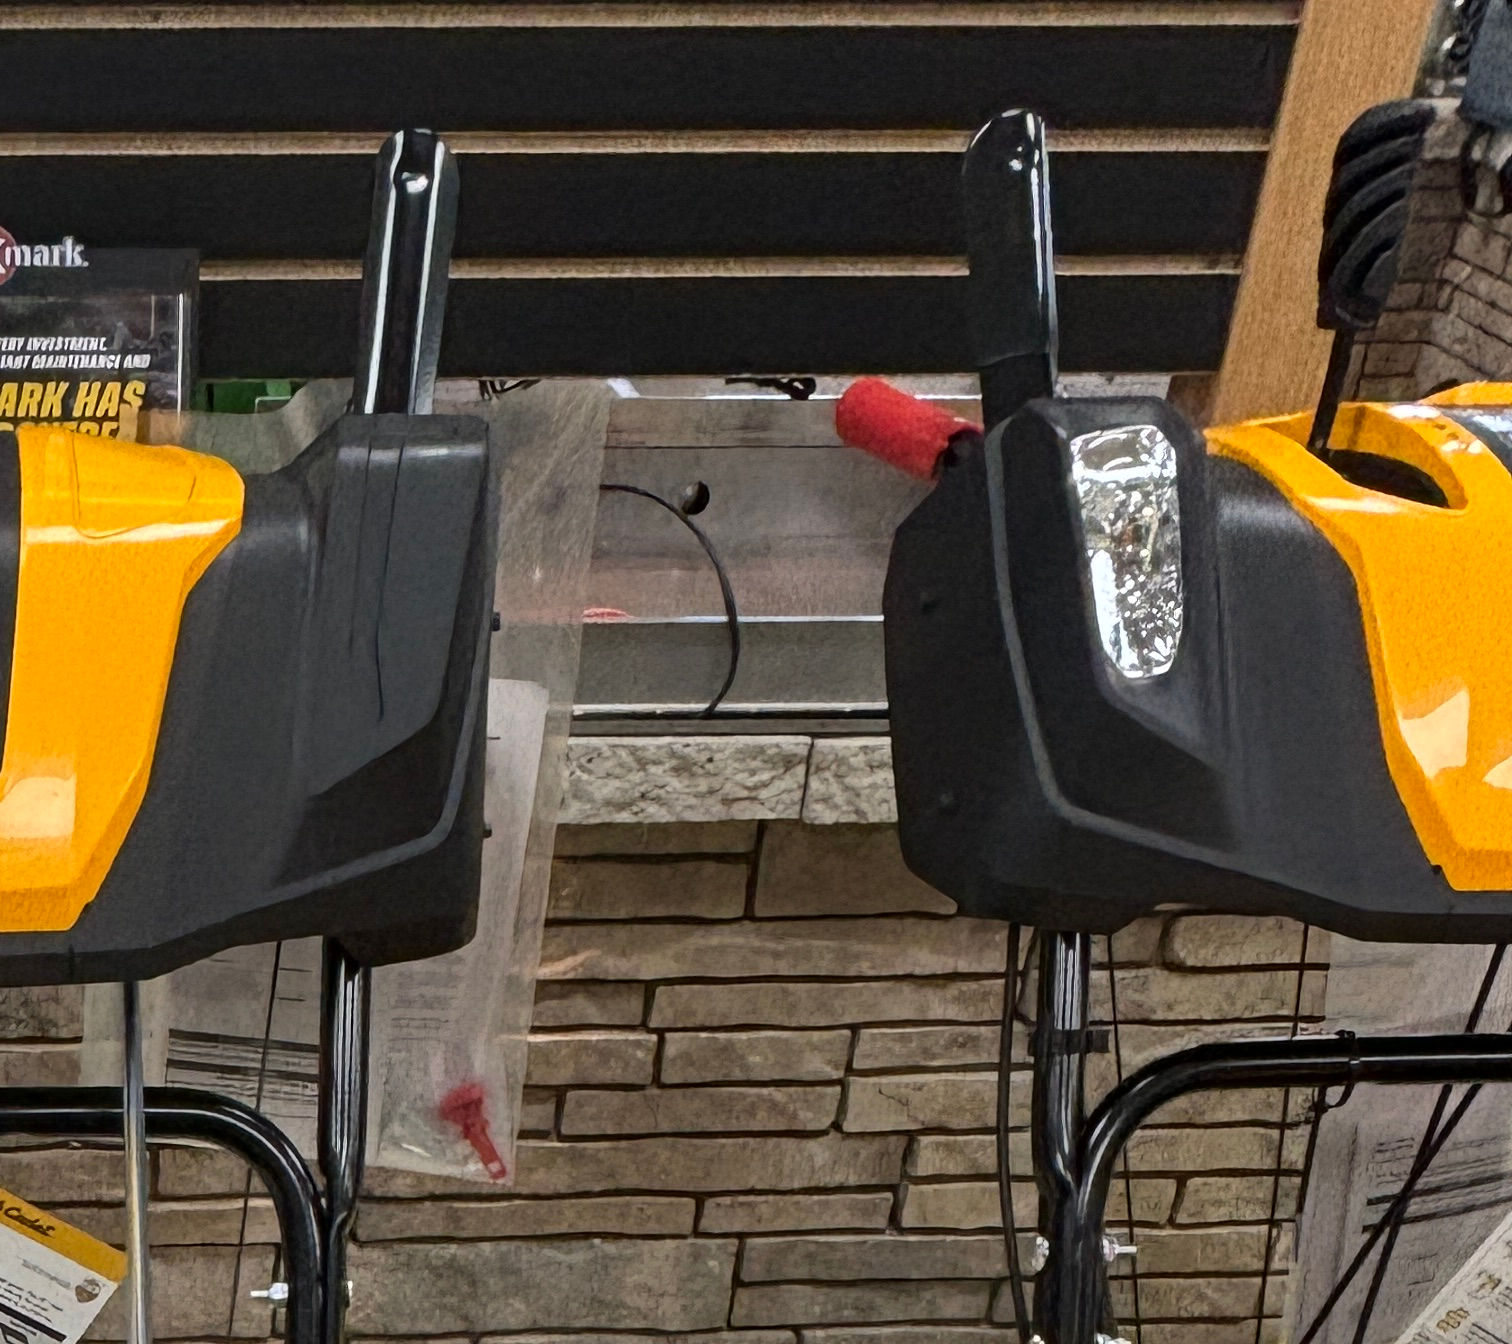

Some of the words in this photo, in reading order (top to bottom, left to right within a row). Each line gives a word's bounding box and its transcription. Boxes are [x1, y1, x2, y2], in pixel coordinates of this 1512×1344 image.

[31, 354, 121, 369] MAINTENANCE
[123, 354, 151, 369] AND
[72, 380, 146, 418] HAS
